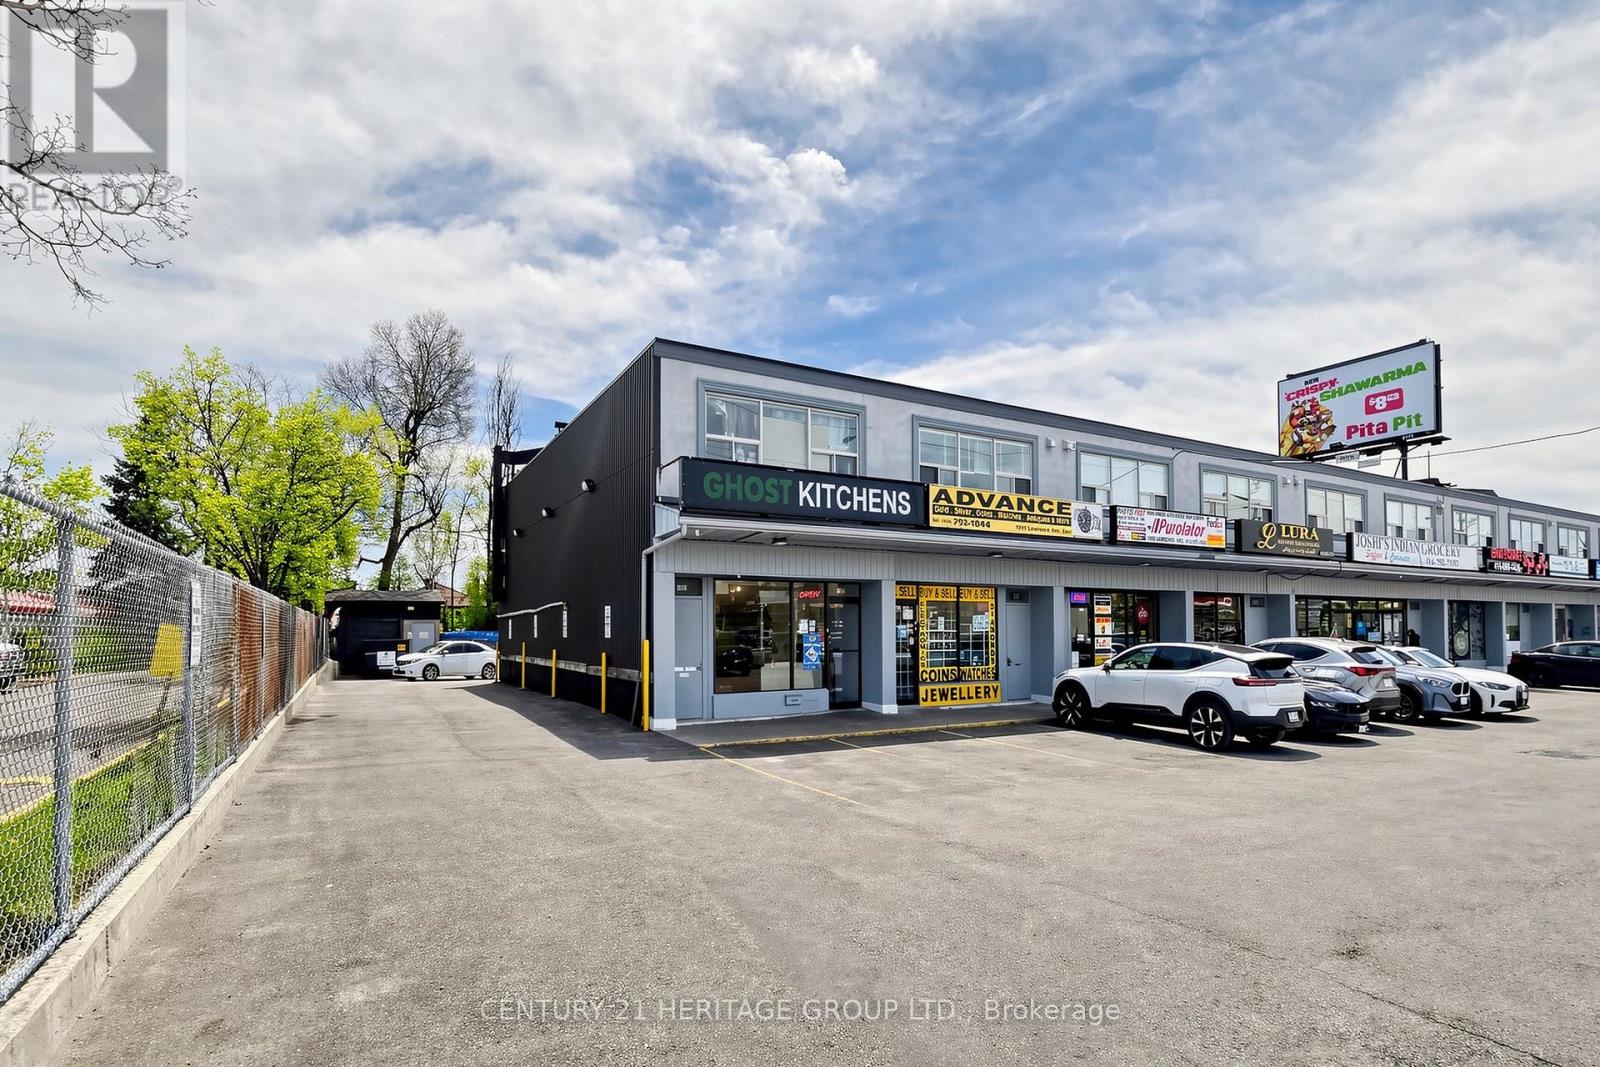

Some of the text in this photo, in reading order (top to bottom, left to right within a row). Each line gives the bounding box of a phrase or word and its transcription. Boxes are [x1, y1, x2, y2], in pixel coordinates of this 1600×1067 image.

[1285, 377, 1338, 401] CRISPY
[1319, 361, 1427, 402] SHAWARMA
[1346, 412, 1423, 440] Pita Pit
[703, 471, 912, 515] GHOST KITCHENS
[932, 488, 1072, 516] ADVANCE
[1158, 518, 1206, 537] Purolator
[1280, 524, 1319, 541] LURA
[1421, 543, 1461, 558] GROCERY
[798, 590, 821, 599] OPEN
[900, 586, 915, 597] SELL
[919, 587, 934, 598] BUY
[941, 588, 957, 599] SELL
[979, 589, 994, 599] SELL
[921, 667, 996, 682] COINS WATCHES
[921, 685, 999, 703] JEWELLERY
